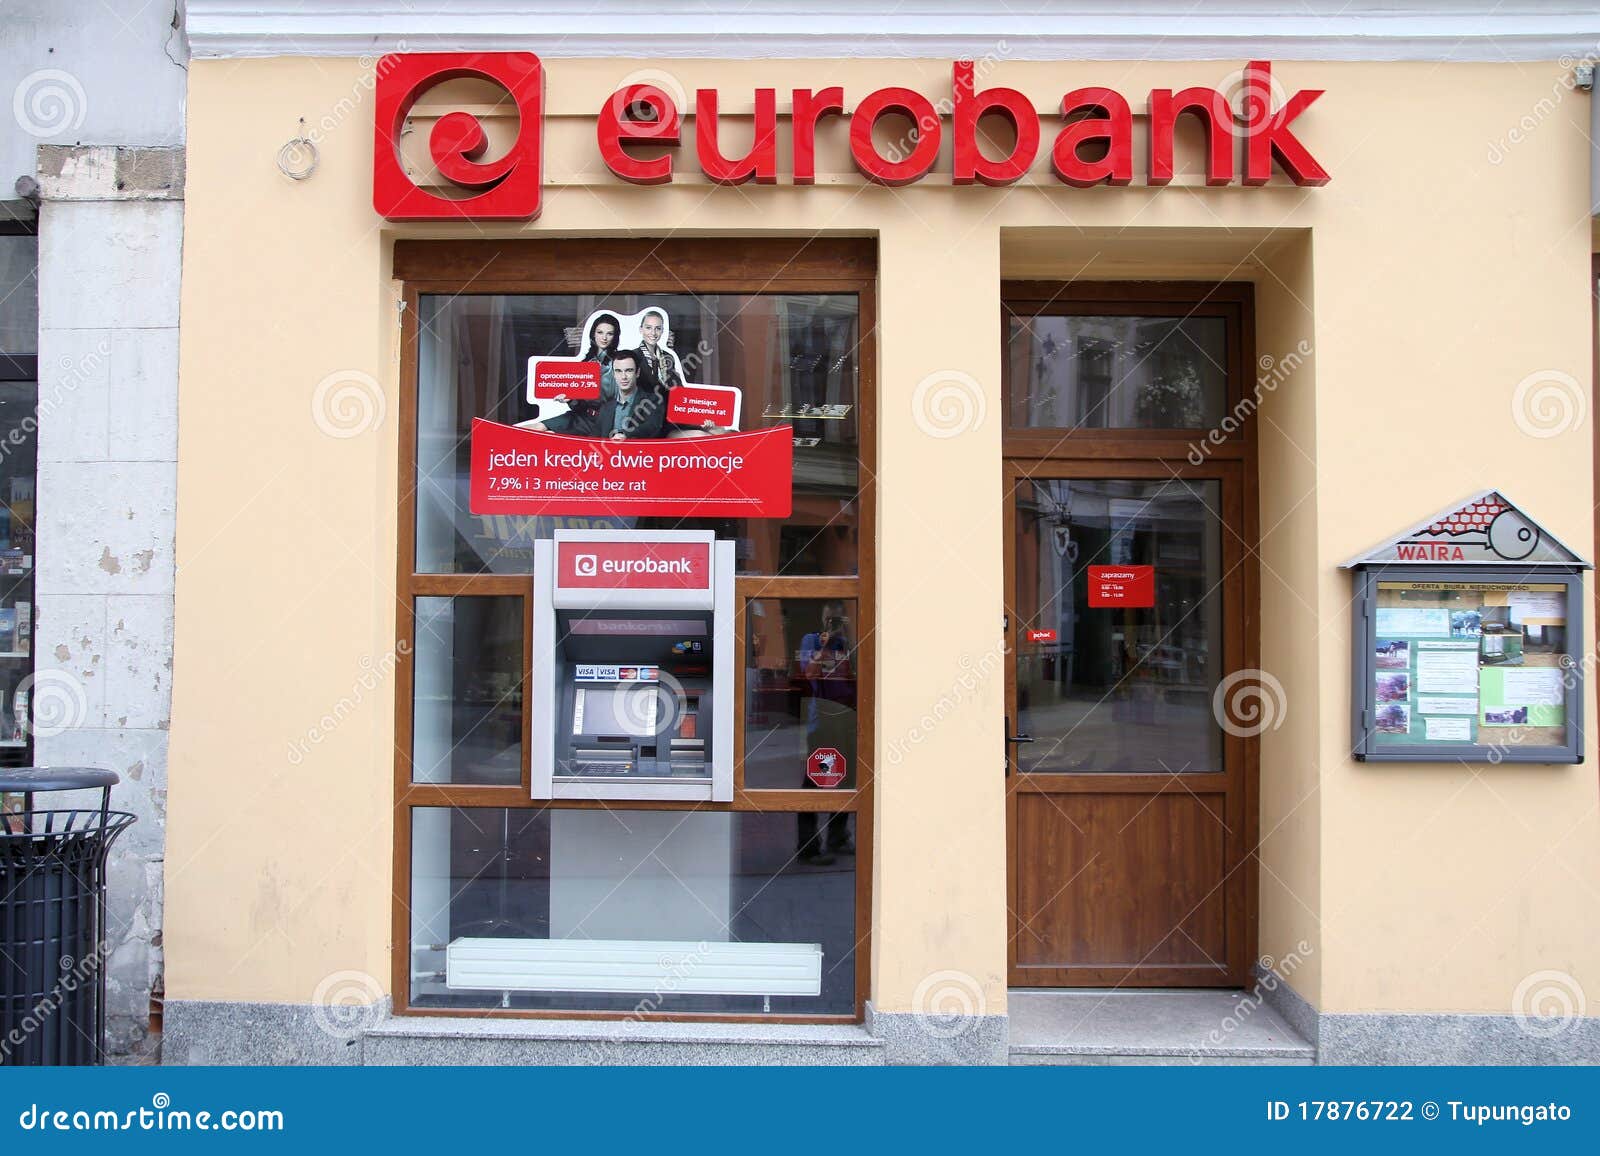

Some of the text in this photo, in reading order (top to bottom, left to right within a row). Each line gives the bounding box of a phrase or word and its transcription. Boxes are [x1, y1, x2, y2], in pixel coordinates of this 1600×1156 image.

[597, 60, 1330, 187] eurobank
[581, 381, 598, 389] 7,9%
[674, 404, 686, 412] bez
[689, 398, 718, 407] miesiące
[488, 449, 744, 474] jeden kredyt, dwie promocje
[489, 477, 647, 493] 7,9% i 3 miesiące bez rat
[1397, 540, 1465, 560] WATRA
[602, 557, 692, 574] eurobank
[1101, 572, 1135, 580] zapraszamy
[597, 621, 679, 632] bankomat
[578, 667, 594, 676] VISA
[600, 667, 616, 676] VISA
